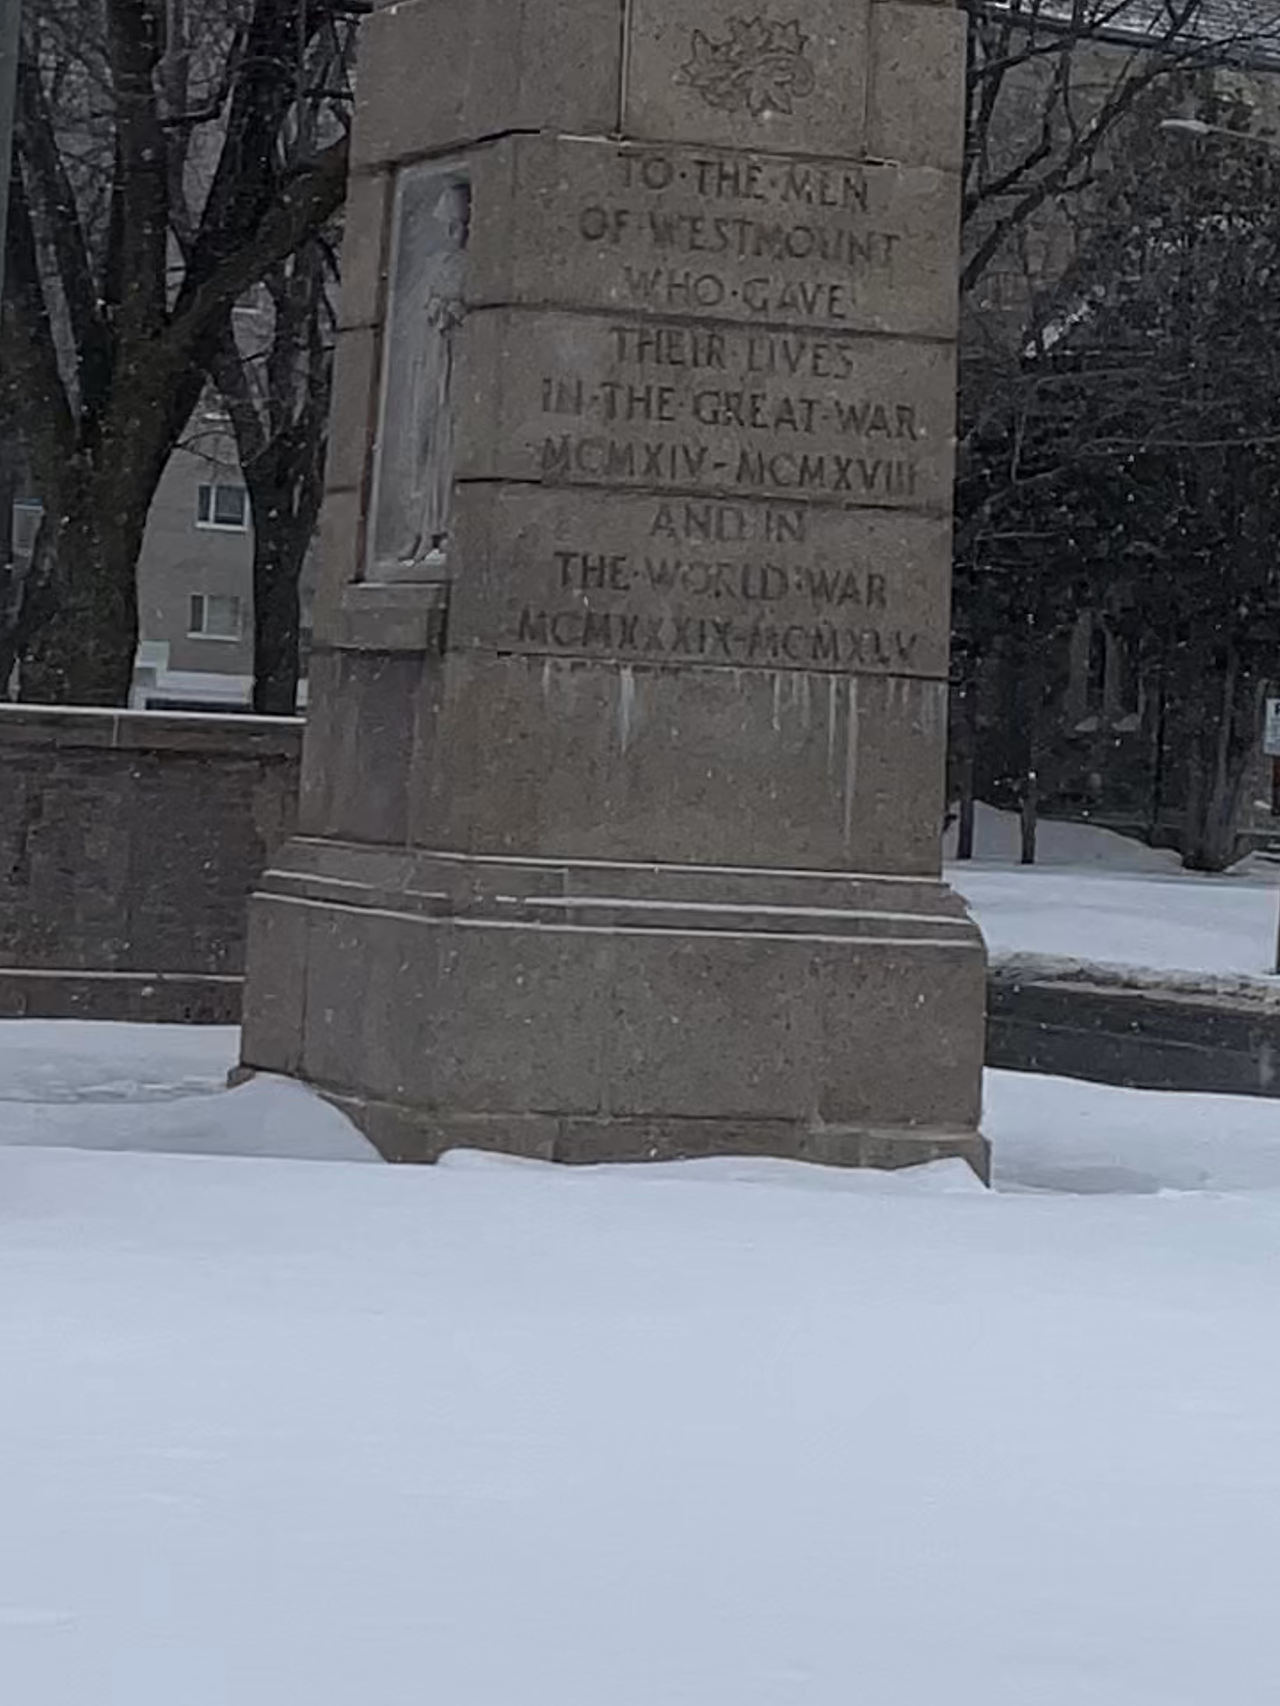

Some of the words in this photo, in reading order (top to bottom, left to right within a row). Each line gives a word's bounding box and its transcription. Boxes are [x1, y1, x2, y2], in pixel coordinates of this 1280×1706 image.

[617, 151, 672, 190] TO
[693, 159, 766, 200] THE
[780, 162, 869, 213] MEN
[579, 206, 630, 244] OF
[646, 209, 901, 268] WESTMOUNT
[623, 265, 724, 307] WHO
[742, 276, 848, 321] GAVE
[610, 326, 727, 370] THEIR
[747, 339, 854, 380] LIVES
[541, 377, 583, 416] IN
[600, 381, 676, 422] THE
[693, 389, 821, 435] GREAT
[833, 399, 919, 442] WAR
[650, 503, 747, 542] AND
[764, 508, 806, 544] IN
[553, 551, 631, 592] THE
[643, 555, 789, 602] WORLD
[804, 566, 887, 609] WAR
